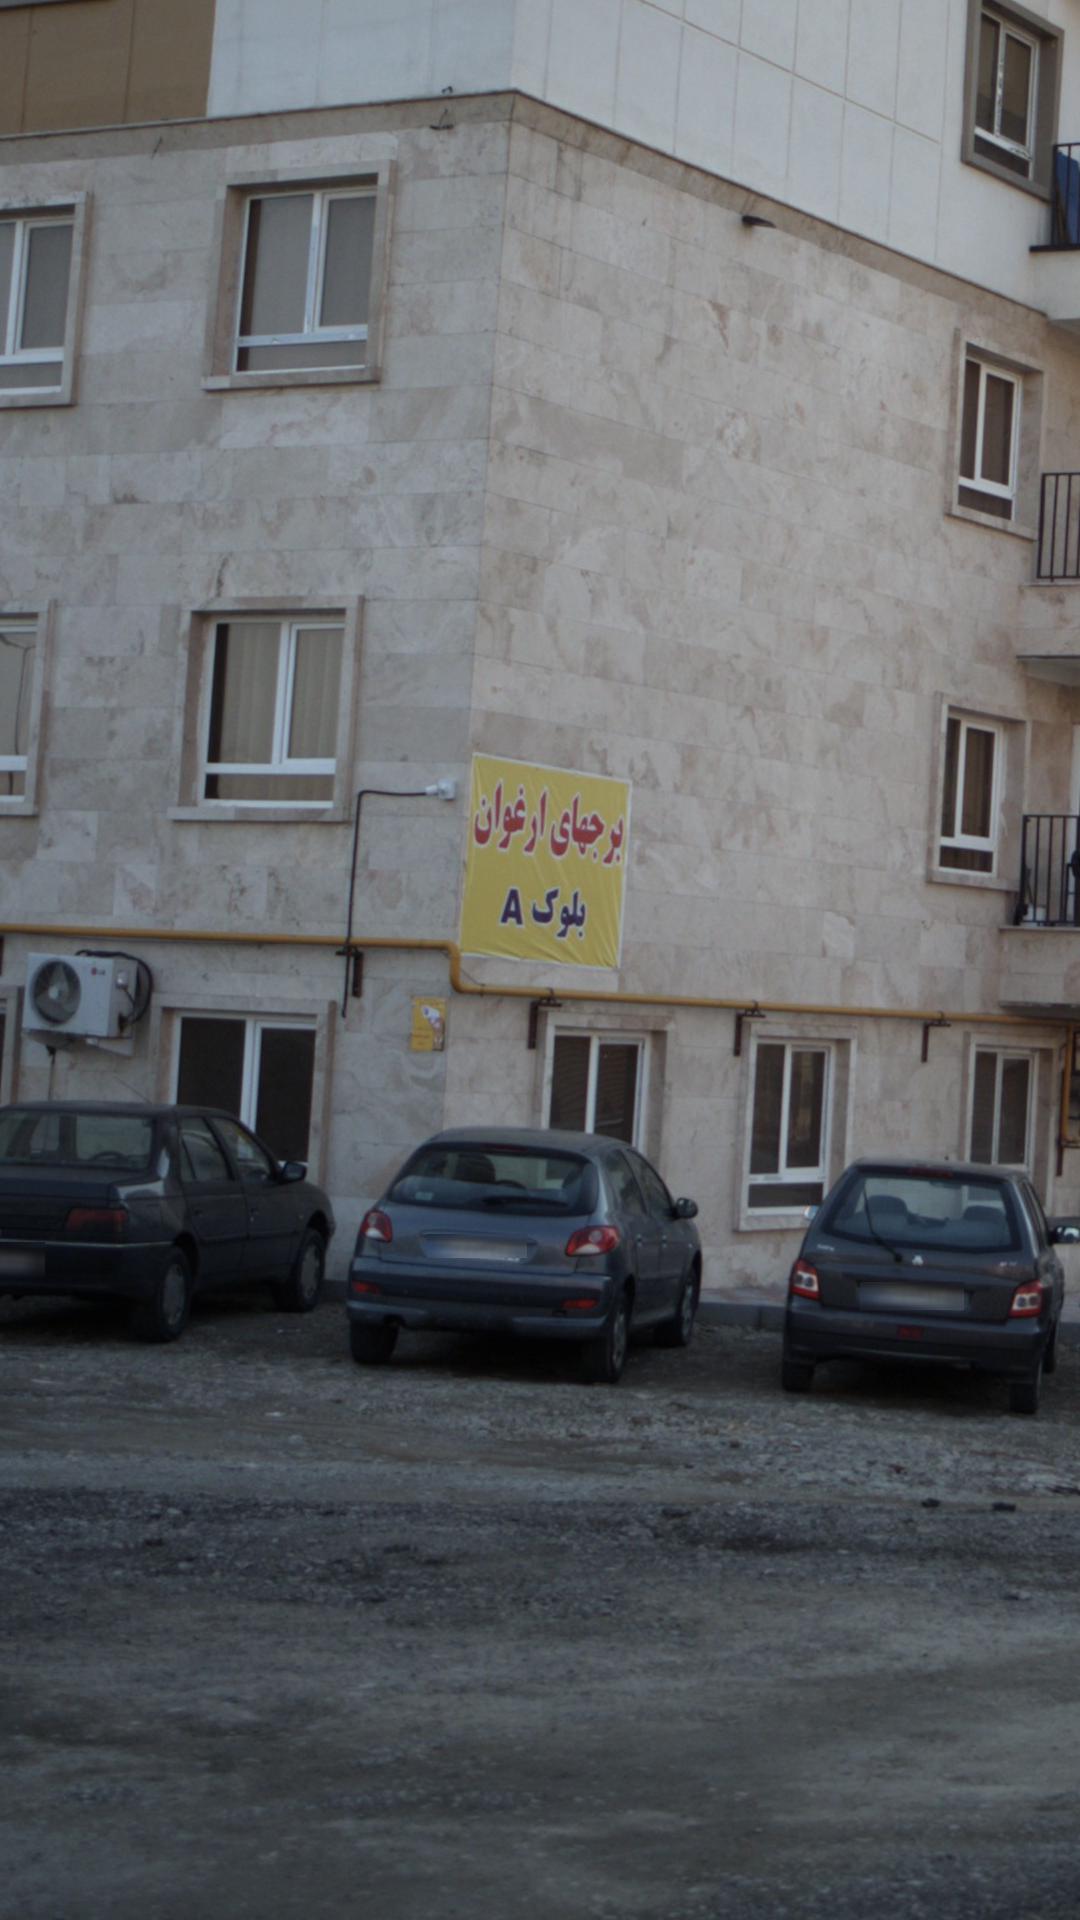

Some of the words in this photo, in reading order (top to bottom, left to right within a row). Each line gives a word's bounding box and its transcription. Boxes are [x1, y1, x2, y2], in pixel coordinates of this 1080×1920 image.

[474, 783, 548, 853] ارغوان
[550, 795, 624, 864] برجهای
[500, 888, 524, 926] A
[532, 889, 587, 938] بلوک
